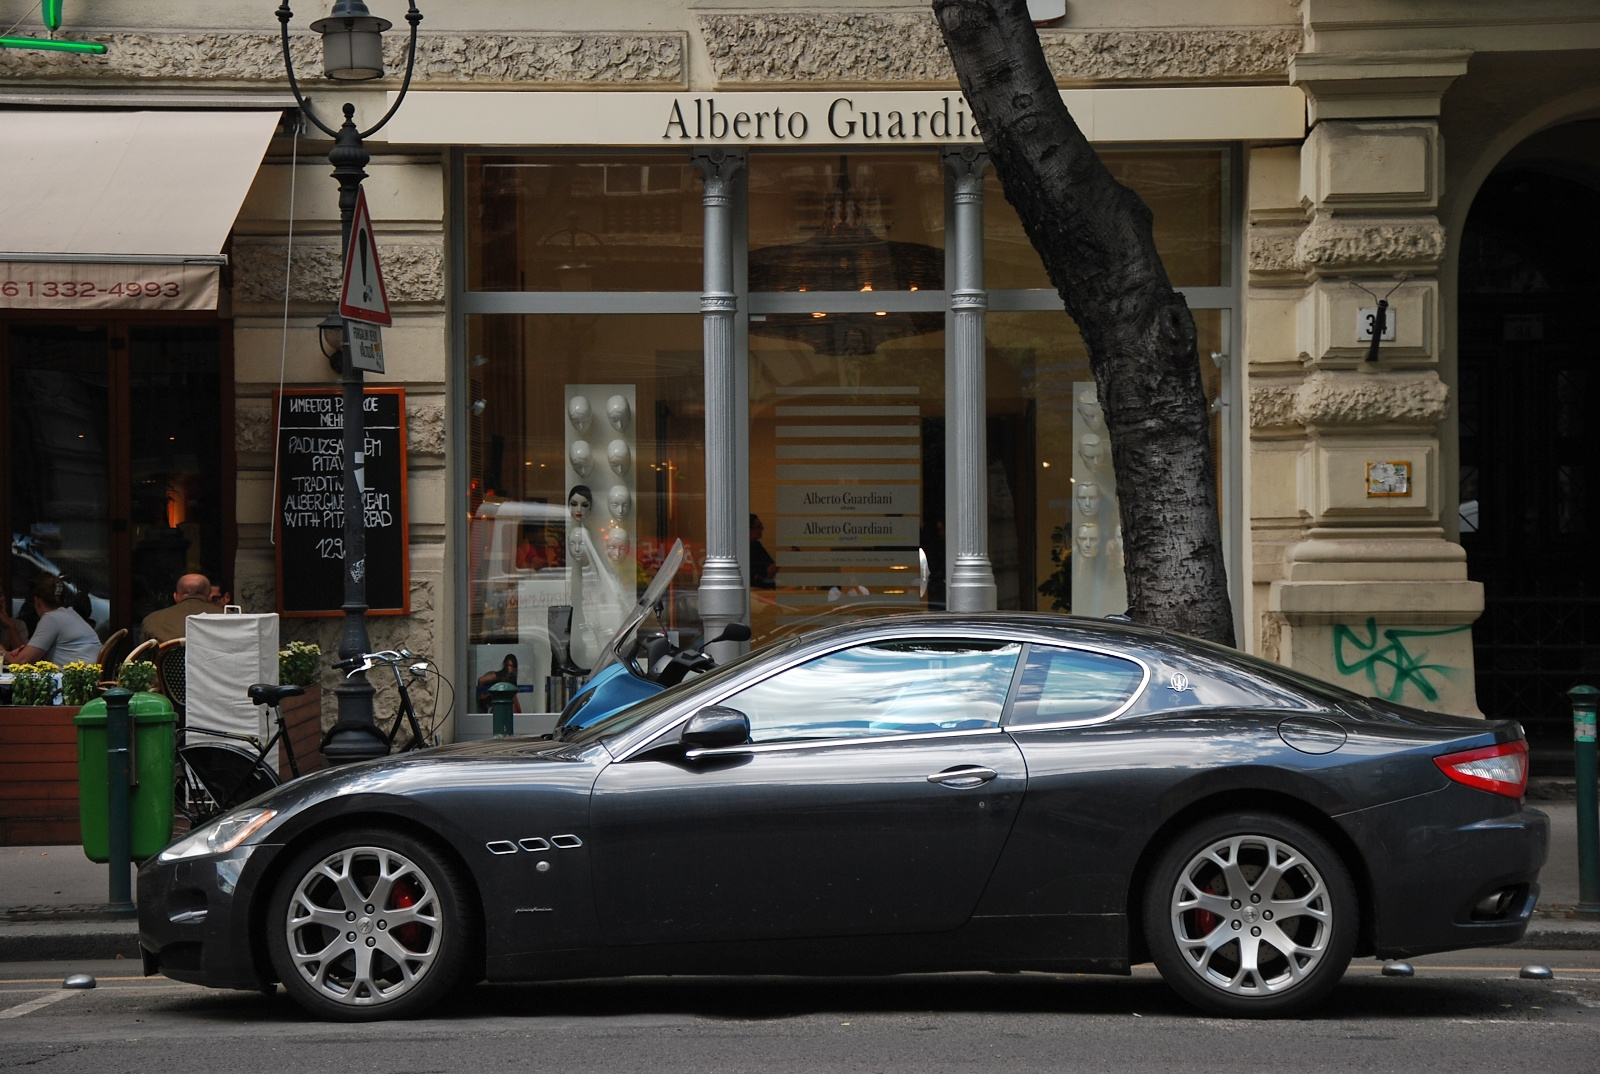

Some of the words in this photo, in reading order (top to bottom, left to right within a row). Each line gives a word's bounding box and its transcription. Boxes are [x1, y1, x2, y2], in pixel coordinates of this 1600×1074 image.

[662, 98, 808, 139] Alberto
[320, 413, 344, 427] МЕН
[803, 493, 841, 505] Alberto
[842, 492, 892, 505] Guardiani
[284, 512, 321, 527] WITH
[803, 522, 841, 535] Alberto
[842, 522, 893, 535] Guardiani
